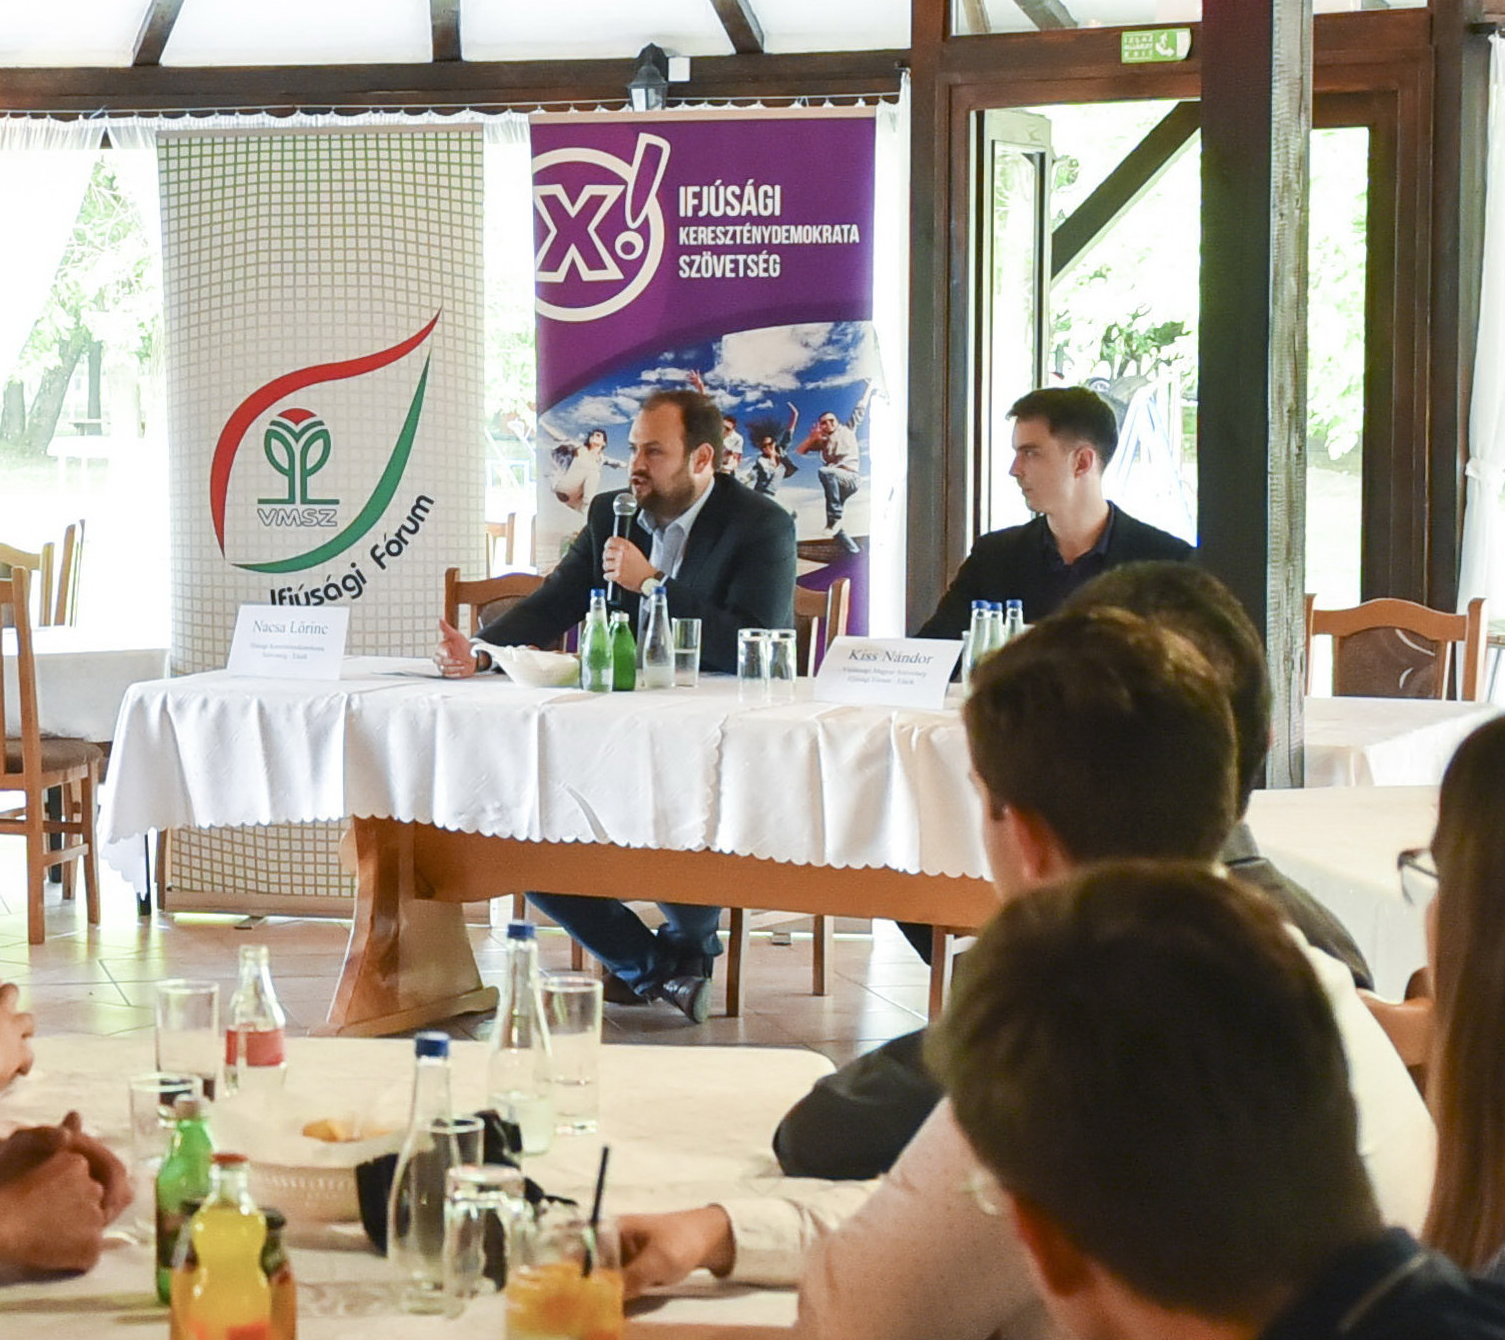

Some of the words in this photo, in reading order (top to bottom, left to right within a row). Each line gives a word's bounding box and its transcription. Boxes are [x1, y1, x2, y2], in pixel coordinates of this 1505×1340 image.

[678, 179, 782, 217] IFJÚSÁGI
[678, 222, 861, 246] KERESZTÉNYDEMOKRATA
[678, 250, 782, 279] SZÖVETSÉG
[256, 508, 338, 527] VMSZ
[370, 495, 435, 571] Fórum
[252, 620, 286, 635] Nacsa
[848, 648, 879, 661] Kiss
[882, 650, 934, 664] Nándor
